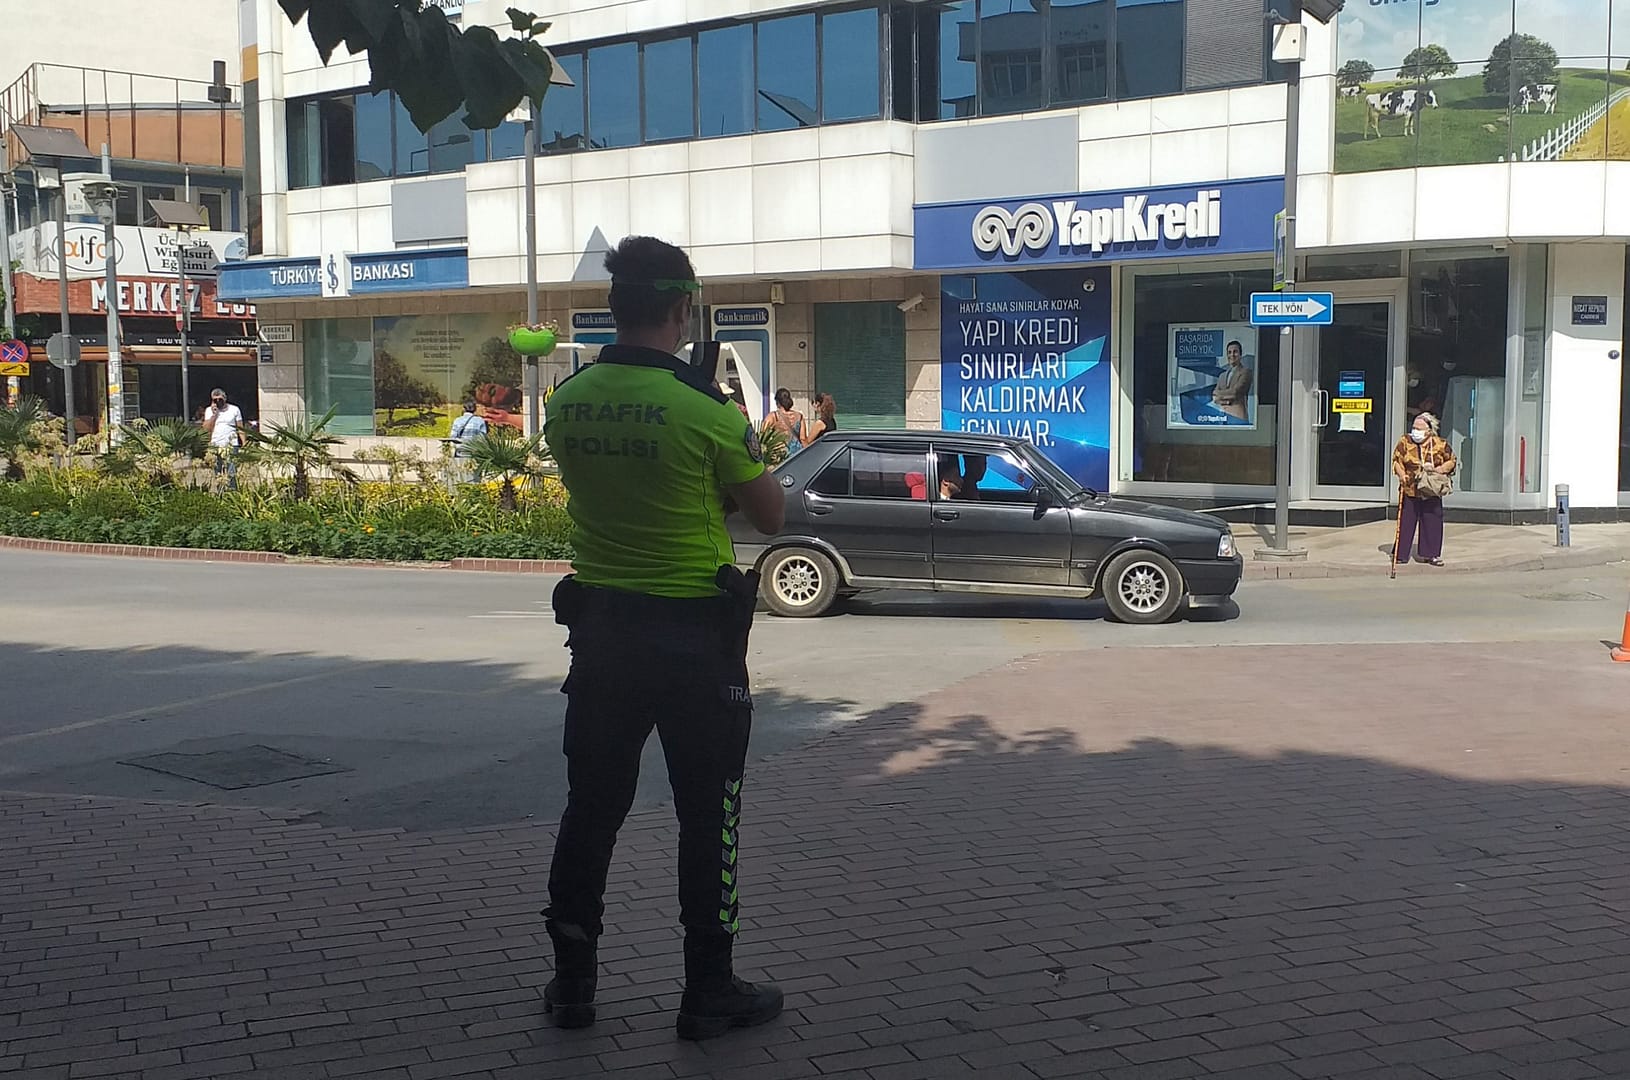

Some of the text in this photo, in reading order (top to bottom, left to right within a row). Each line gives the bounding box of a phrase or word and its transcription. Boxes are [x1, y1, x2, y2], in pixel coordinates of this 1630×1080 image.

[1052, 190, 1220, 252] YapıKredi
[158, 232, 210, 248] Ücsiz
[161, 259, 207, 271] Eğtimi
[270, 263, 414, 285] TÜRKİYE BANKASI
[91, 280, 202, 313] MERKEZ
[960, 299, 1081, 313] HAYAT SANA SINIRLAR KOYAR.
[718, 312, 767, 322] Bankamatik
[1262, 302, 1303, 313] TEK YÖN
[960, 320, 1005, 346] YAPI
[1179, 334, 1214, 344] BAŞARIDA
[1179, 344, 1198, 354] SINIR
[961, 352, 1067, 379] SINIRLARI
[961, 386, 1086, 413] KALDIRMAK
[1008, 420, 1055, 447] VAR.
